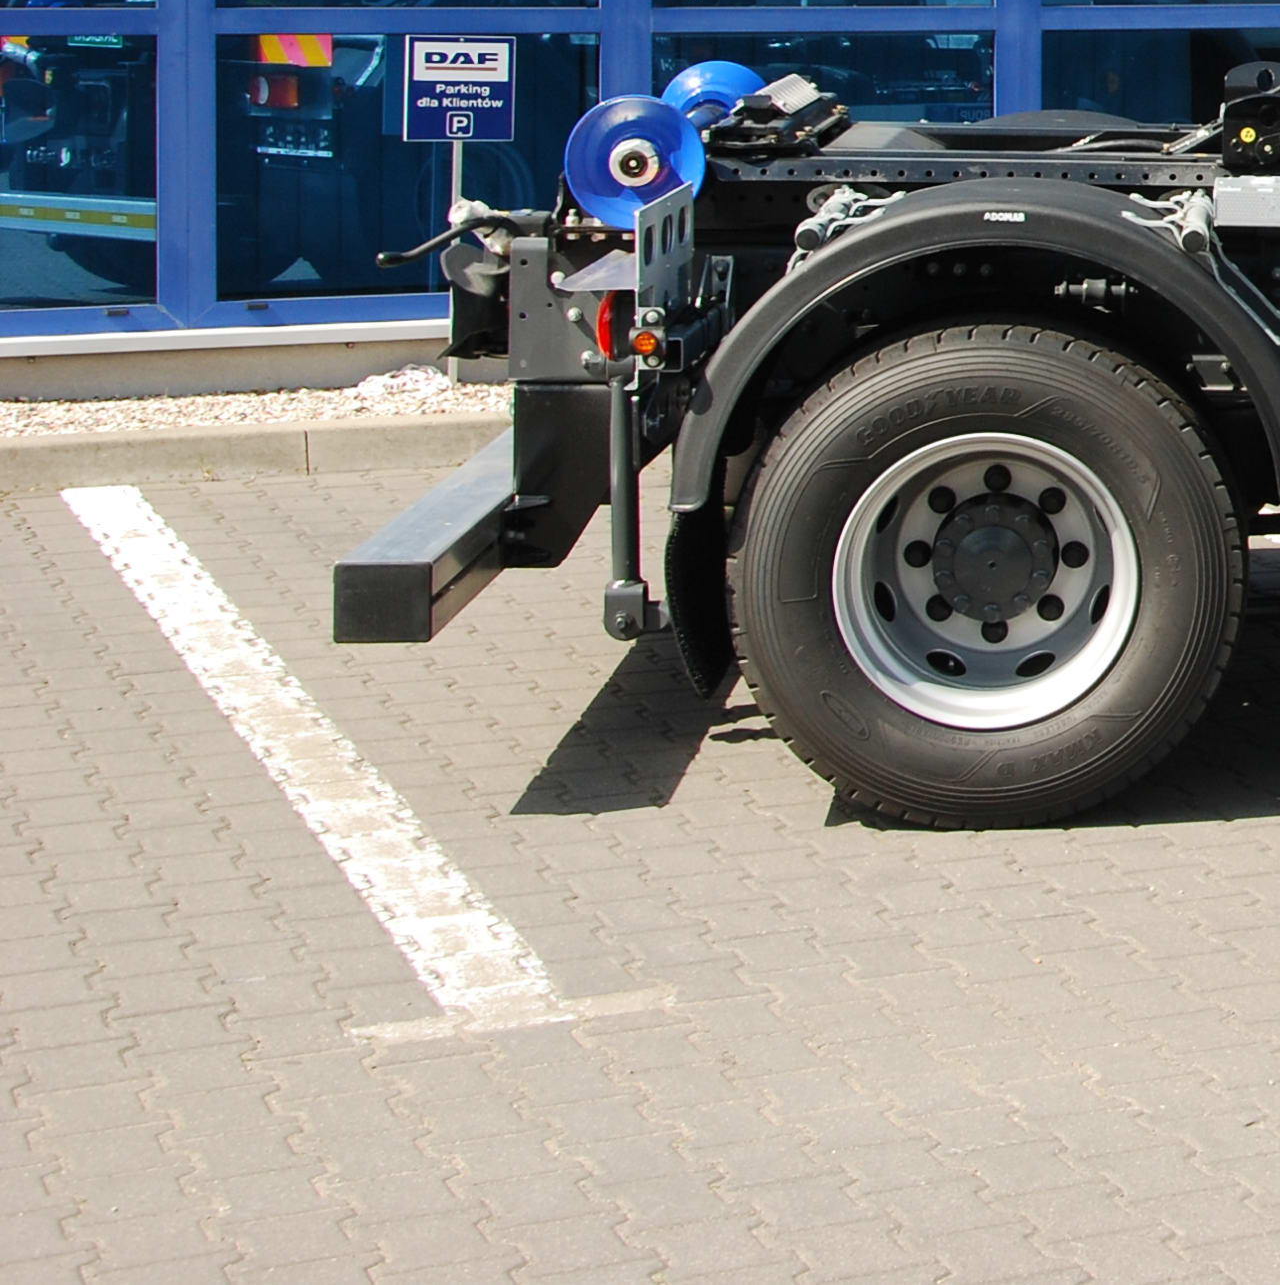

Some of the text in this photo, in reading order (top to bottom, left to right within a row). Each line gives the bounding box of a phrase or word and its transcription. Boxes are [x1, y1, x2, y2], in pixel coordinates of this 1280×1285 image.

[424, 51, 499, 65] DAF
[435, 84, 490, 97] Parking
[416, 97, 503, 108] dla Klientów
